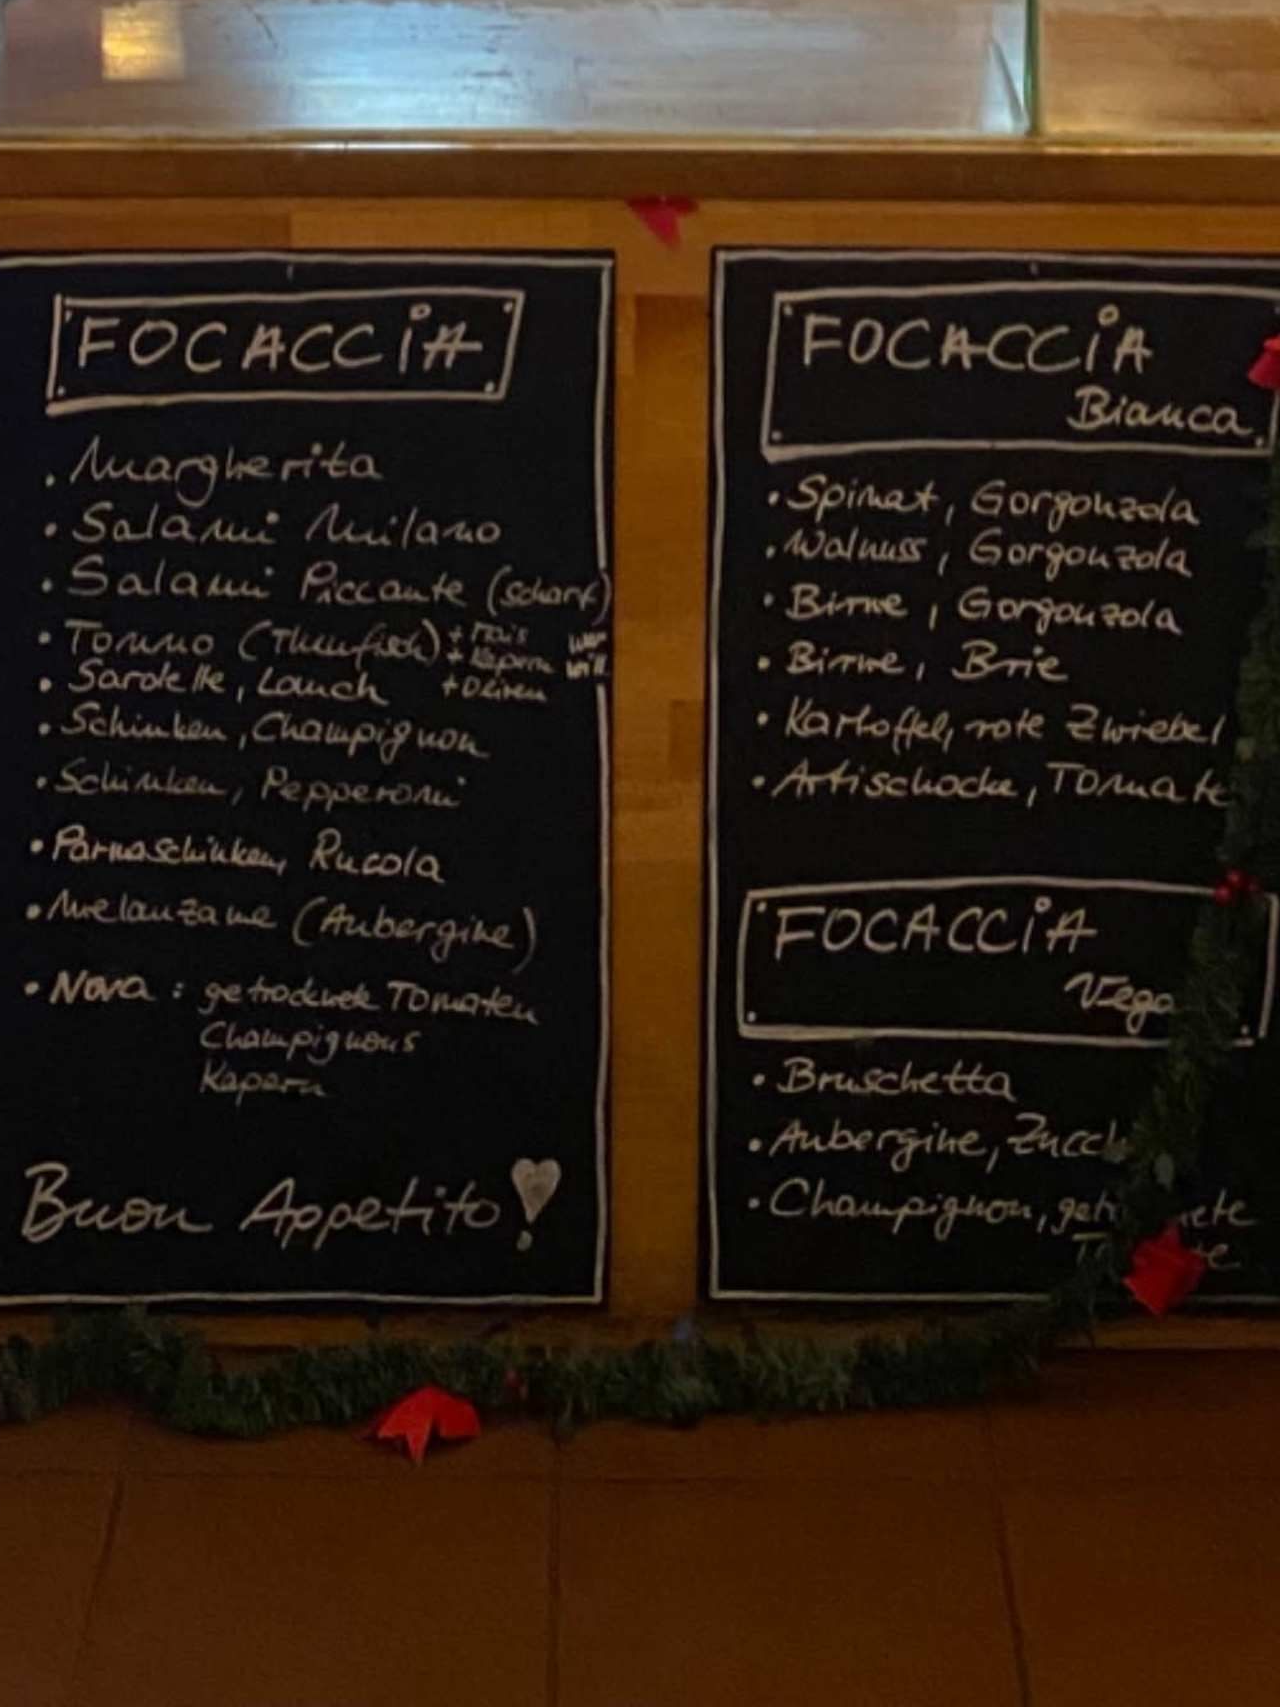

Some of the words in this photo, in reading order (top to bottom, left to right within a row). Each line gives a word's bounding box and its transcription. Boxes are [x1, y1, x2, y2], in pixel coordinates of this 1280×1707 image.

[1066, 384, 1253, 436] Bianca
[71, 435, 384, 508] Margherita
[71, 500, 280, 545] Salami
[304, 502, 502, 550] Milano
[970, 479, 1200, 534] Gorgonzola
[968, 526, 1193, 582] Gorgonzola
[68, 553, 275, 599] Salami
[299, 560, 466, 607] Piccante
[957, 585, 1182, 636] Gorgonzola
[64, 618, 215, 656] Tonno
[951, 639, 1068, 682] Brie
[1065, 702, 1226, 746] Zwiebel
[260, 766, 467, 812] Pepperoni
[309, 827, 445, 884] Rucola
[776, 1056, 1016, 1102] Bruschetta
[21, 1161, 213, 1244] Buon
